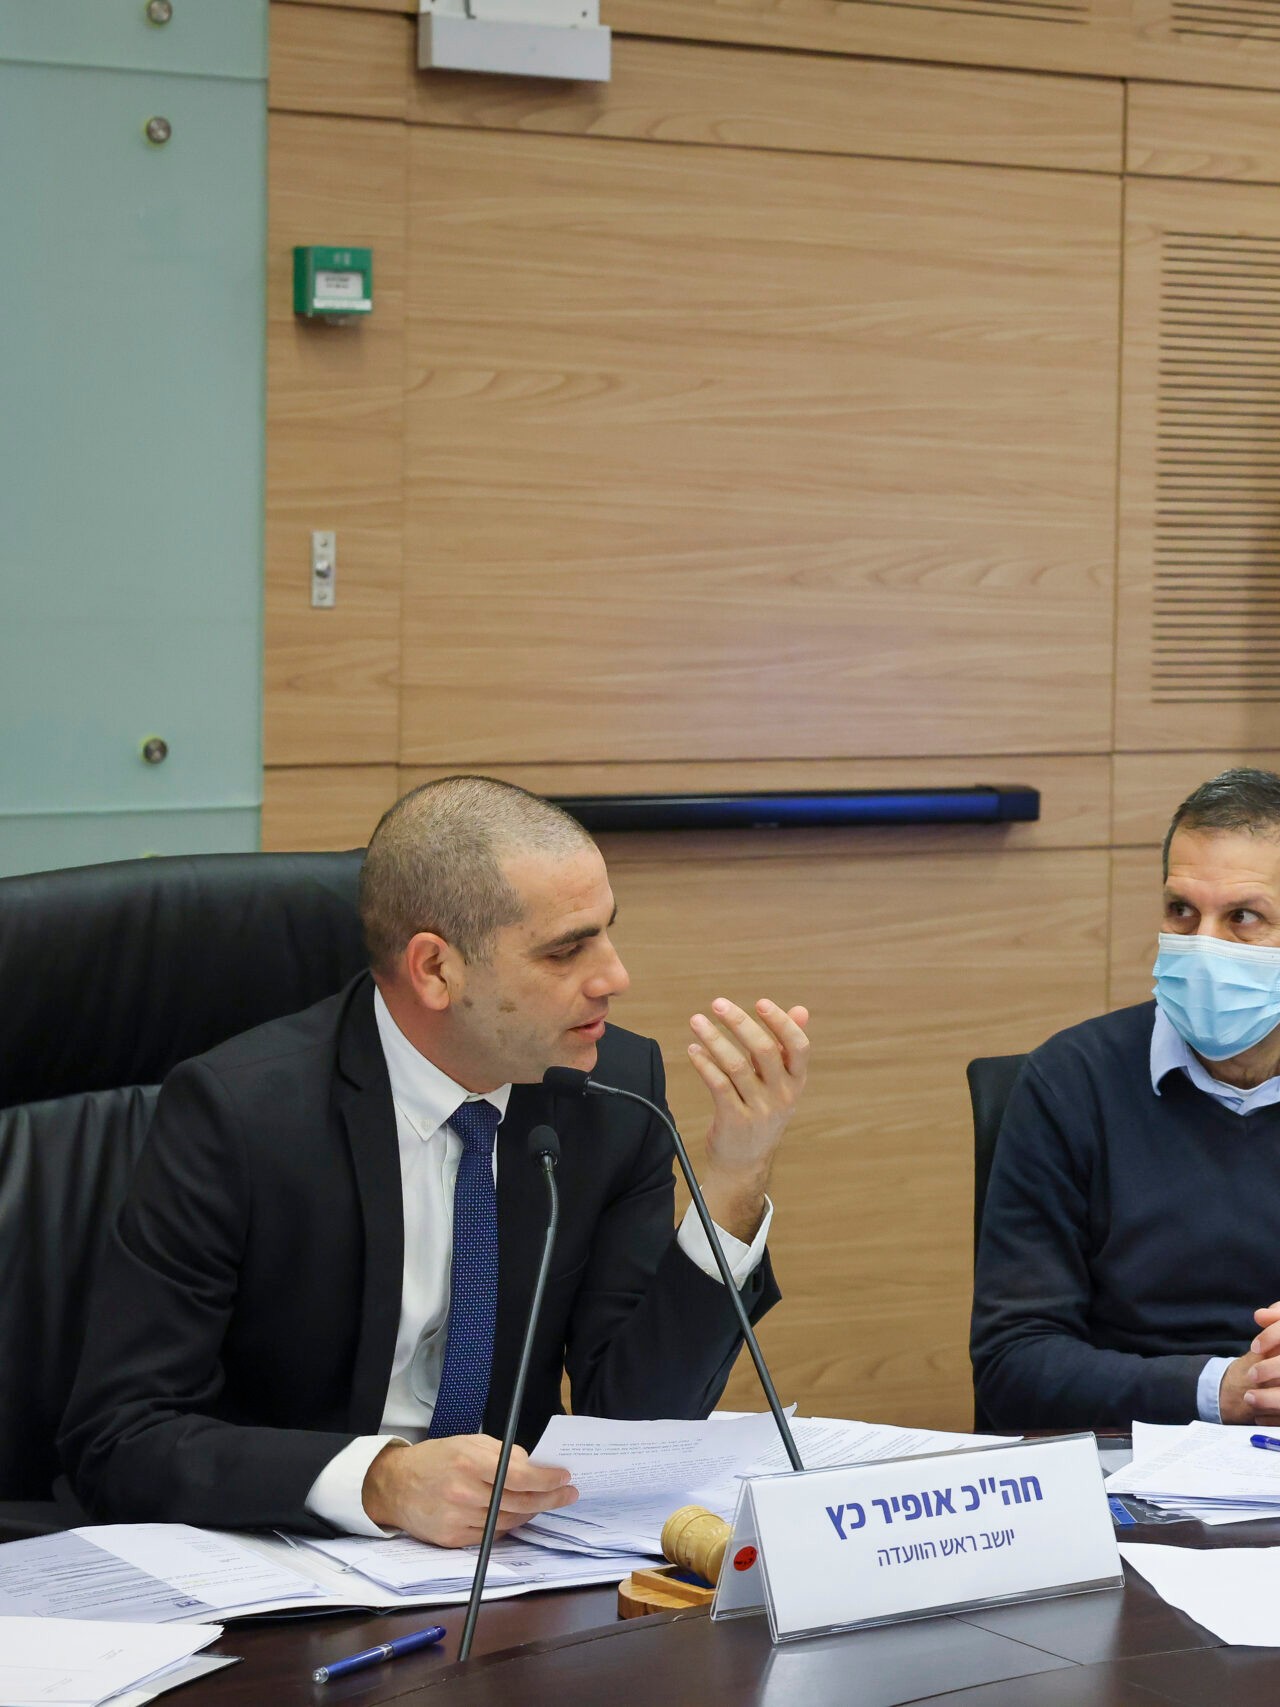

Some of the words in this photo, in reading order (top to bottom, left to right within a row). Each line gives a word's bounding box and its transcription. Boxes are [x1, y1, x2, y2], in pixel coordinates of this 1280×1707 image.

[872, 1487, 957, 1525] אופיר
[961, 1475, 1043, 1512] חה"כ
[826, 1502, 867, 1540] כץ
[877, 1540, 938, 1567] הוועדה
[940, 1535, 977, 1557] ראש
[980, 1528, 1015, 1551] יושב
